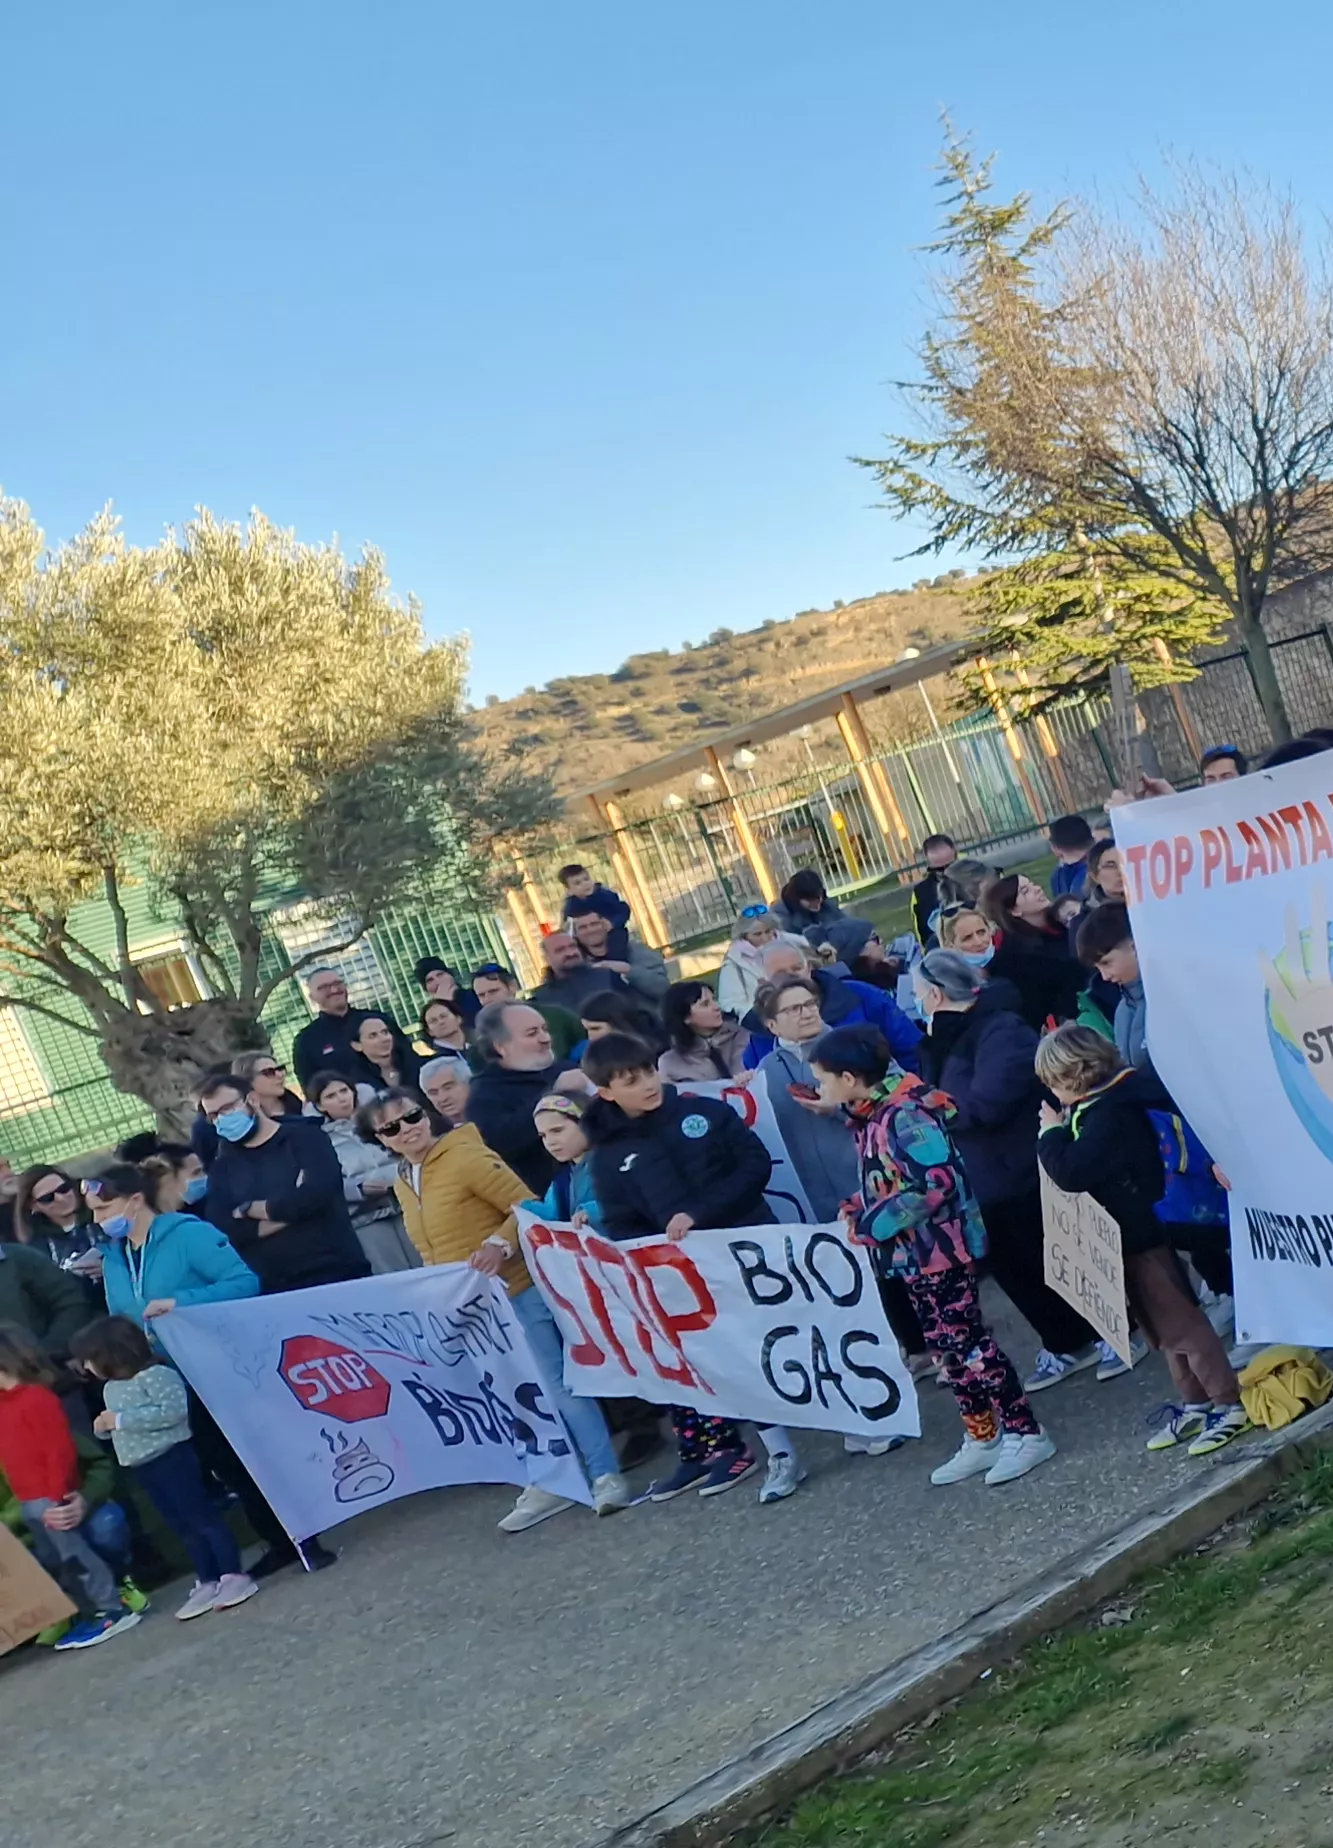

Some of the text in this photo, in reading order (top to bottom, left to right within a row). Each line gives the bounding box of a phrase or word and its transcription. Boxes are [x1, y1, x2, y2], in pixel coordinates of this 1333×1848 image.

[1123, 835, 1195, 906] TOP
[1051, 1203, 1070, 1236] NO
[1245, 1207, 1321, 1268] NUESTRO
[728, 1231, 863, 1307] BIO
[1051, 1243, 1070, 1287] SE
[526, 1224, 718, 1396] STOP
[288, 1354, 373, 1405] STOP
[760, 1325, 901, 1422] GAS
